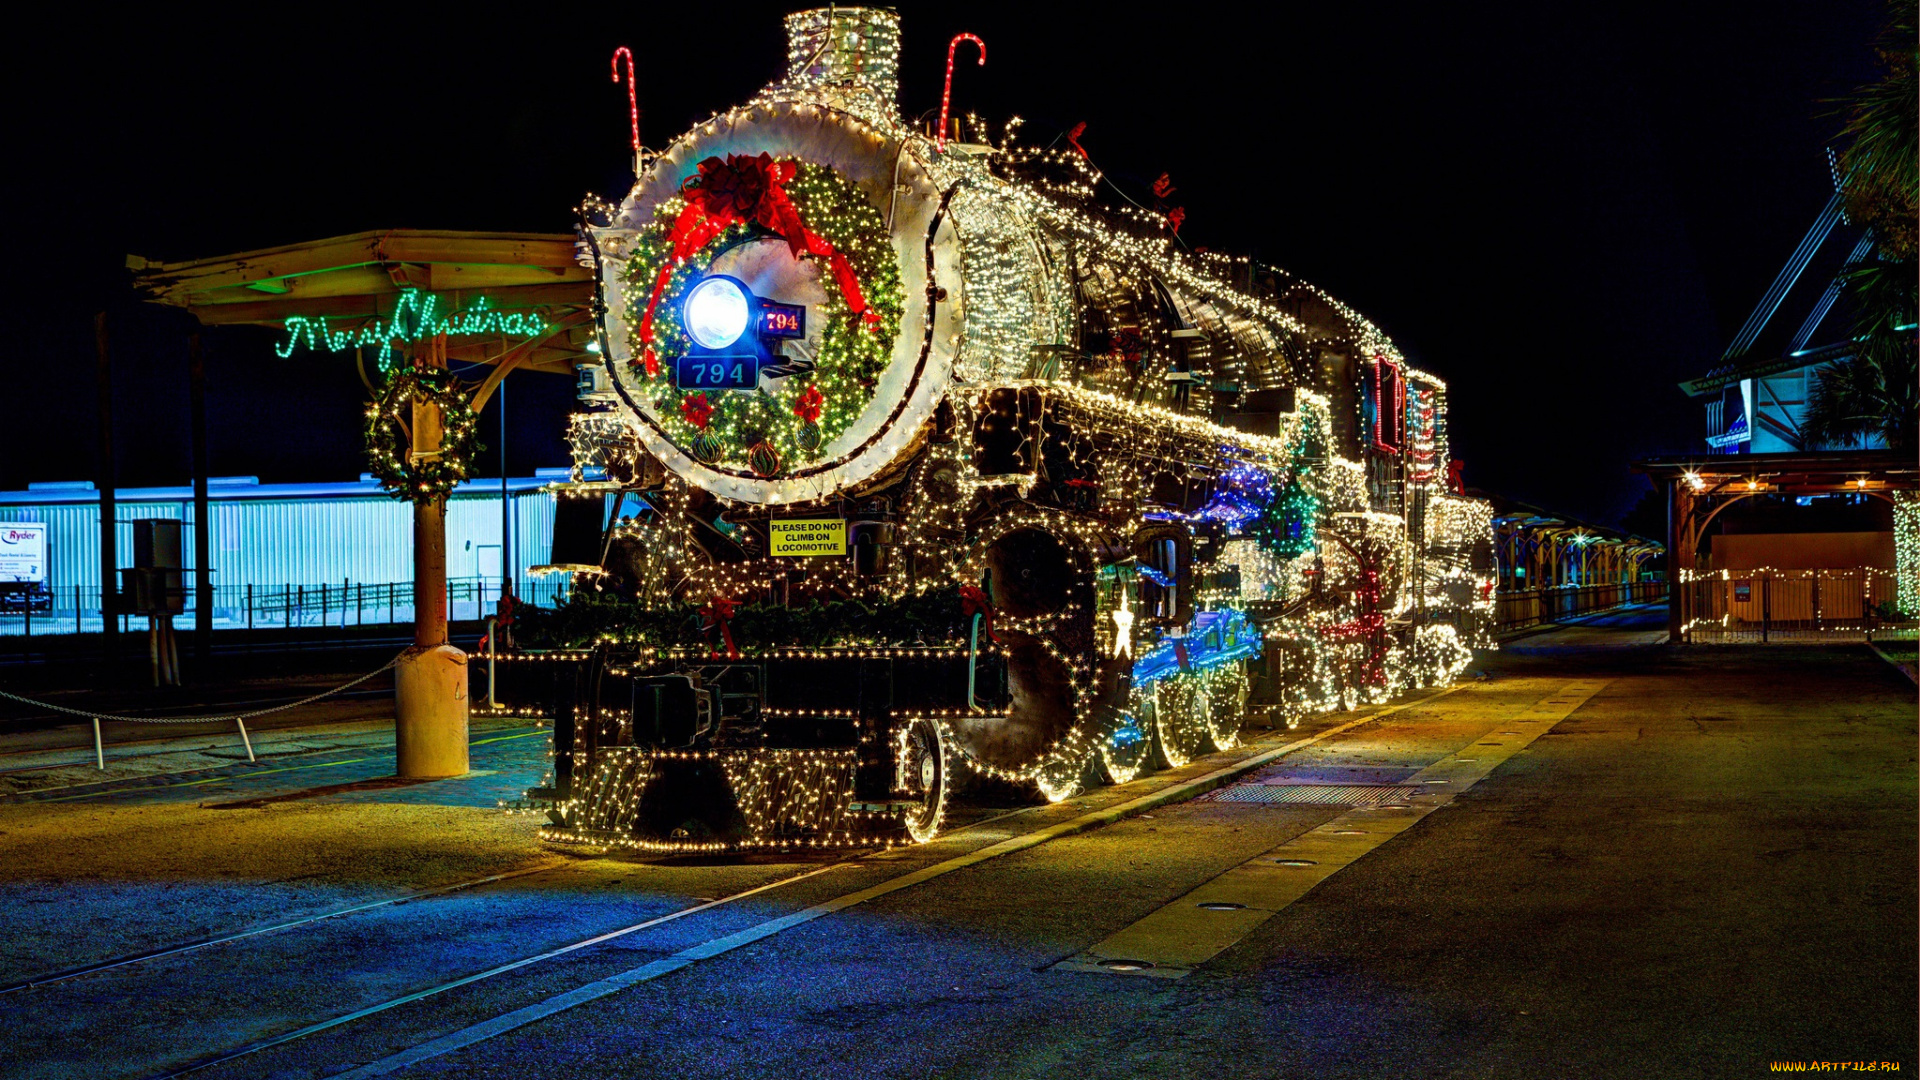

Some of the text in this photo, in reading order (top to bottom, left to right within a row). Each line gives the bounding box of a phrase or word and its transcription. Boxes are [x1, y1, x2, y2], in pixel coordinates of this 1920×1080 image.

[766, 313, 798, 330] 794
[275, 287, 544, 372] Merry Christmas
[691, 363, 744, 384] 794
[771, 523, 843, 532] PLEASE DO NOT
[9, 530, 36, 541] Ryder
[816, 533, 830, 541] ON
[777, 543, 839, 552] LOCOMOTIVE
